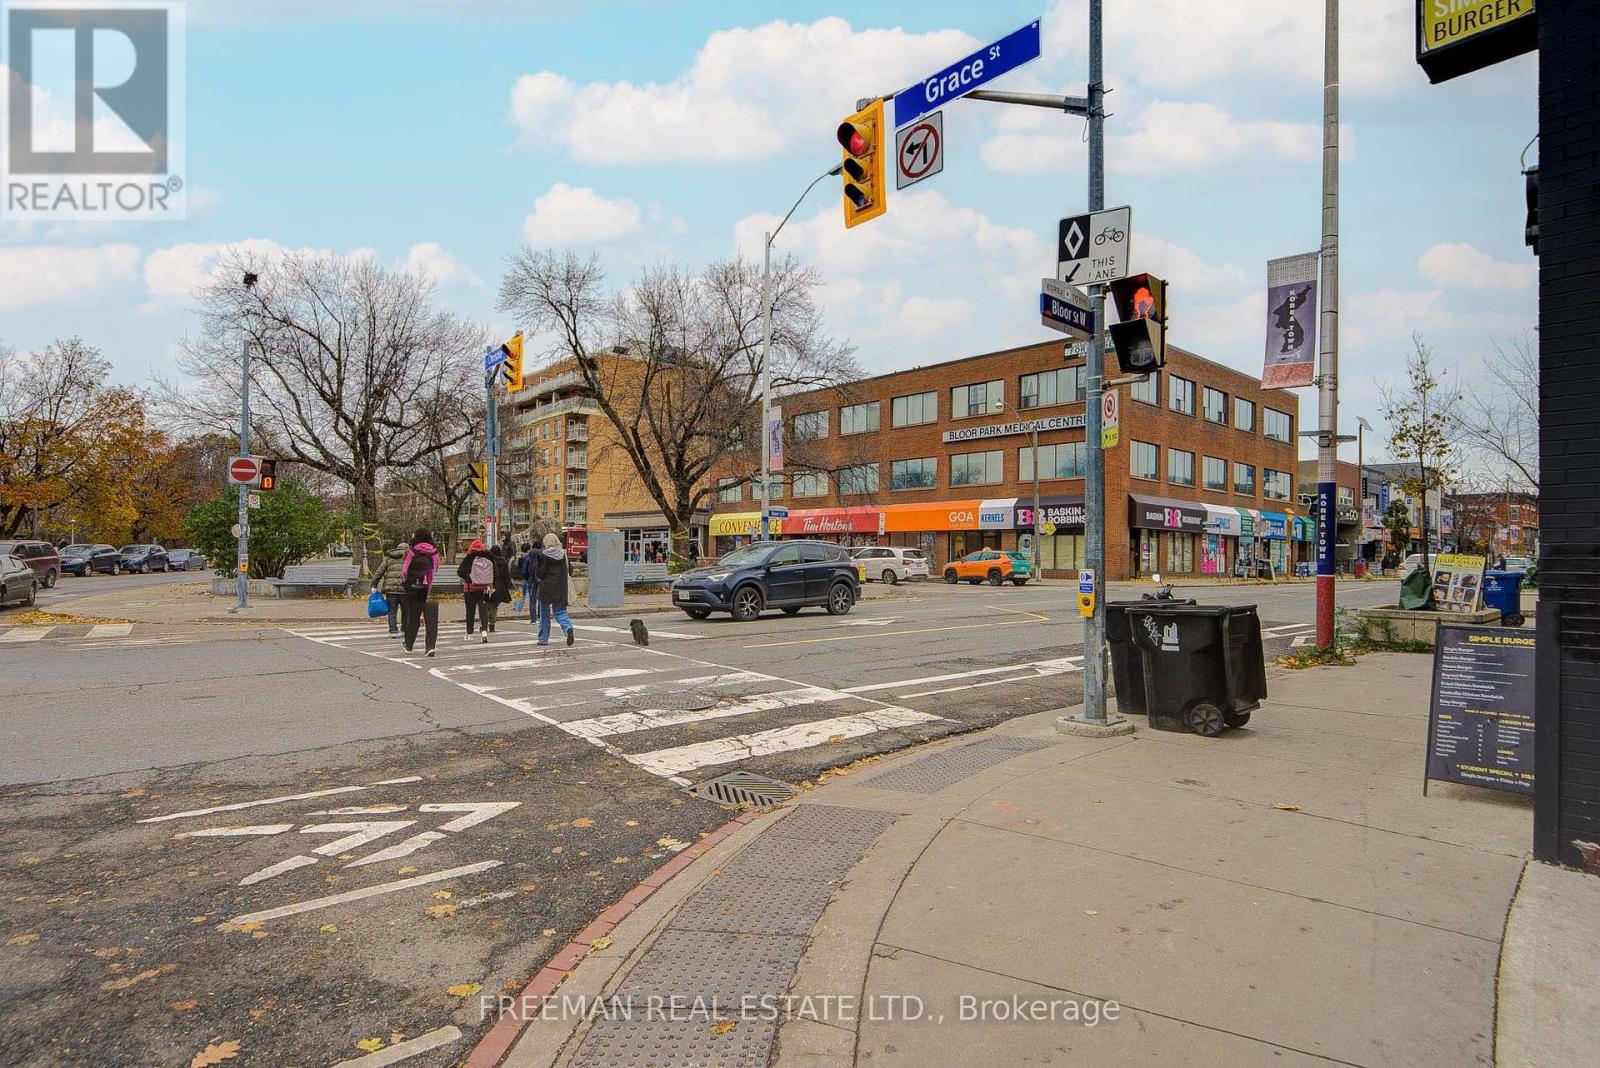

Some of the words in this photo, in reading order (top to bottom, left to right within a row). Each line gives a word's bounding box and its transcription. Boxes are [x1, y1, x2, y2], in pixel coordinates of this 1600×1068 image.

[1434, 0, 1521, 42] BURGER
[925, 58, 984, 103] Grace
[989, 45, 1001, 60] St
[1092, 257, 1115, 275] THIS
[1051, 300, 1072, 322] Bloor
[1079, 312, 1086, 326] W
[1288, 290, 1296, 322] KOREA
[949, 429, 977, 440] BLOOR
[979, 425, 1002, 437] PARK
[1004, 420, 1046, 434] MEDICAL
[949, 511, 975, 522] GOA
[981, 513, 1005, 523] KERNELS
[1047, 506, 1081, 518] BASKIN
[1146, 511, 1164, 521] BASKIN
[719, 518, 781, 534] CONVENIECE
[803, 517, 819, 532] Tim
[819, 516, 853, 532] Hortons
[1468, 635, 1501, 644] SIMPLE
[1503, 637, 1536, 646] BURGE
[1460, 765, 1487, 773] STUDENT
[1489, 769, 1514, 777] SPECIAL
